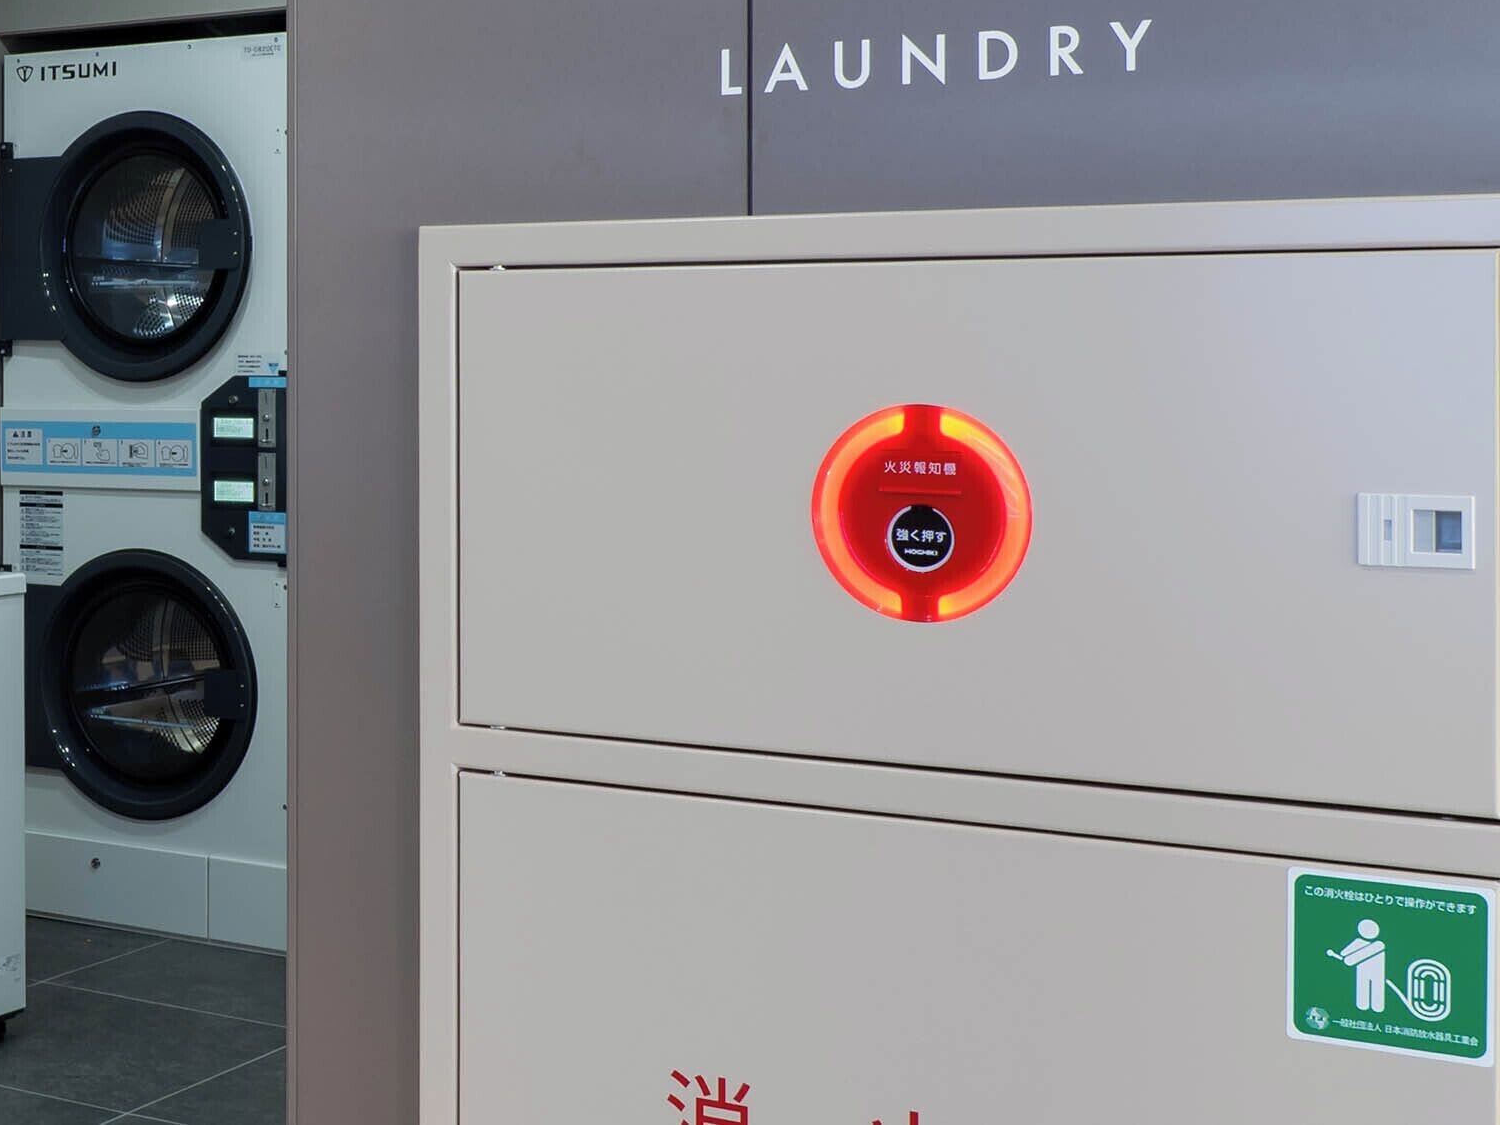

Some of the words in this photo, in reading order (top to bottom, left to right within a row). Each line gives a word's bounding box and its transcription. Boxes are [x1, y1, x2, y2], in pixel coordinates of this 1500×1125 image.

[720, 19, 1152, 96] LAUNDRY
[40, 61, 117, 82] ITSUMI
[884, 460, 957, 476] 火災報知機
[896, 528, 947, 544] 強く押す
[904, 548, 938, 556] HOCHIKI
[1304, 885, 1477, 915] この消火栓はひとりで操作ができます
